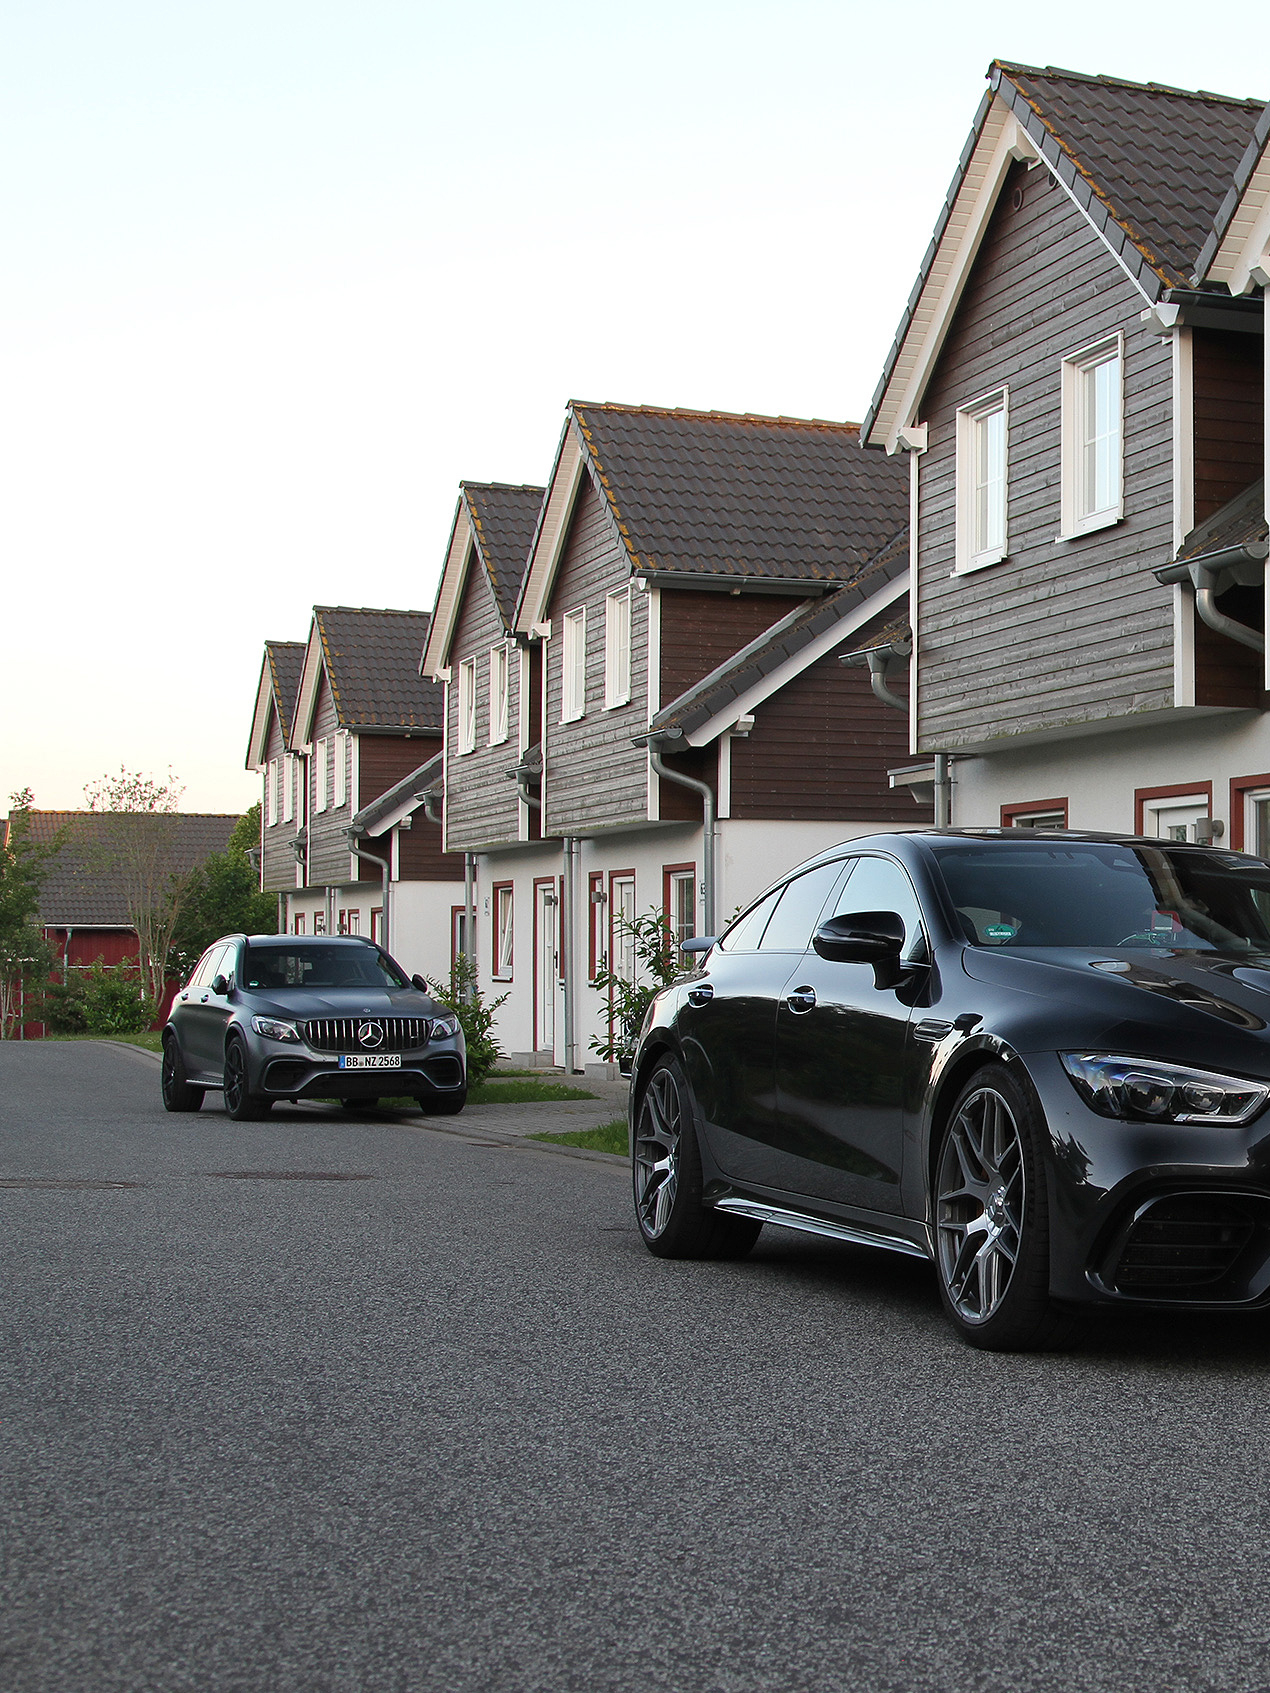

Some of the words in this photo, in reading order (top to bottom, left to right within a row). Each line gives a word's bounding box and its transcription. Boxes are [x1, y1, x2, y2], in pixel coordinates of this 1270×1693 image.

[346, 1056, 358, 1067] BB
[365, 1056, 377, 1067] NZ
[378, 1056, 400, 1067] 2568
